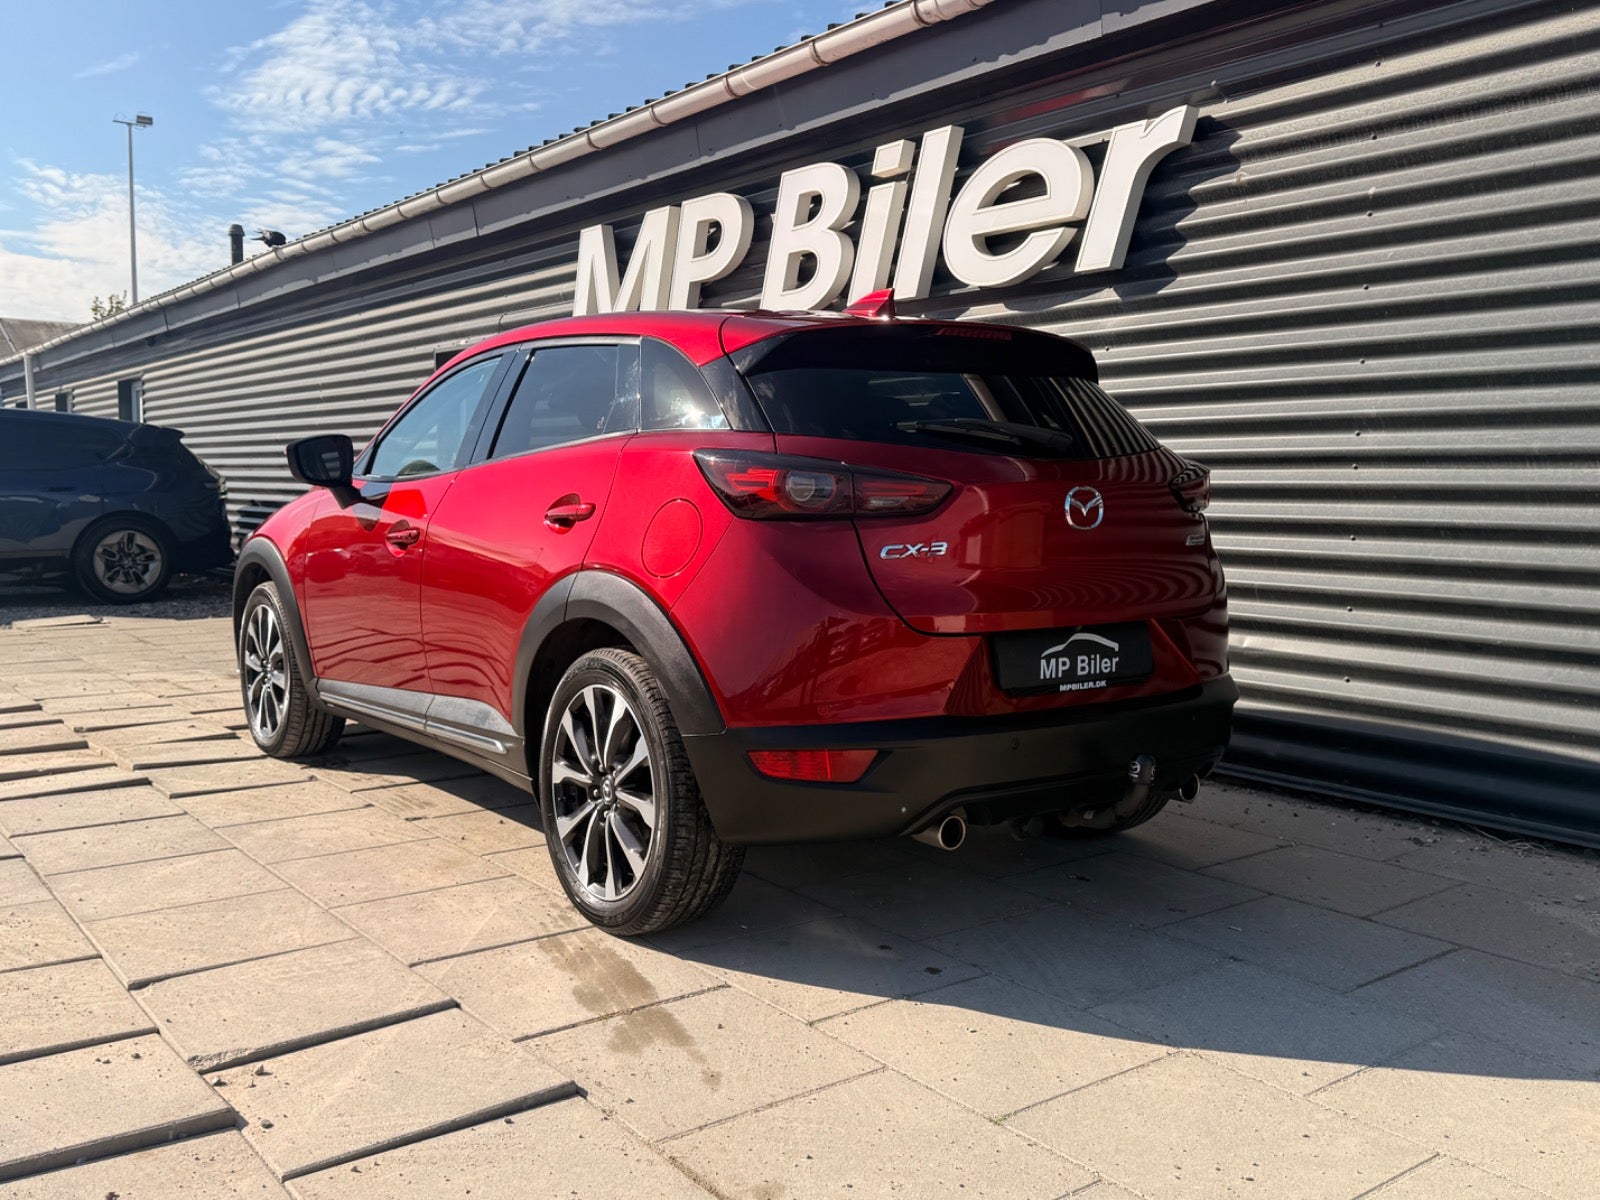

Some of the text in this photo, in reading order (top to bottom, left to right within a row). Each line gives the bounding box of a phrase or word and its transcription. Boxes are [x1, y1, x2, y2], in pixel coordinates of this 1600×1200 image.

[572, 105, 1199, 317] MP Biler
[880, 541, 948, 560] CX-3
[1041, 655, 1119, 679] MP Biler
[1060, 681, 1106, 691] MPBILER.DK
